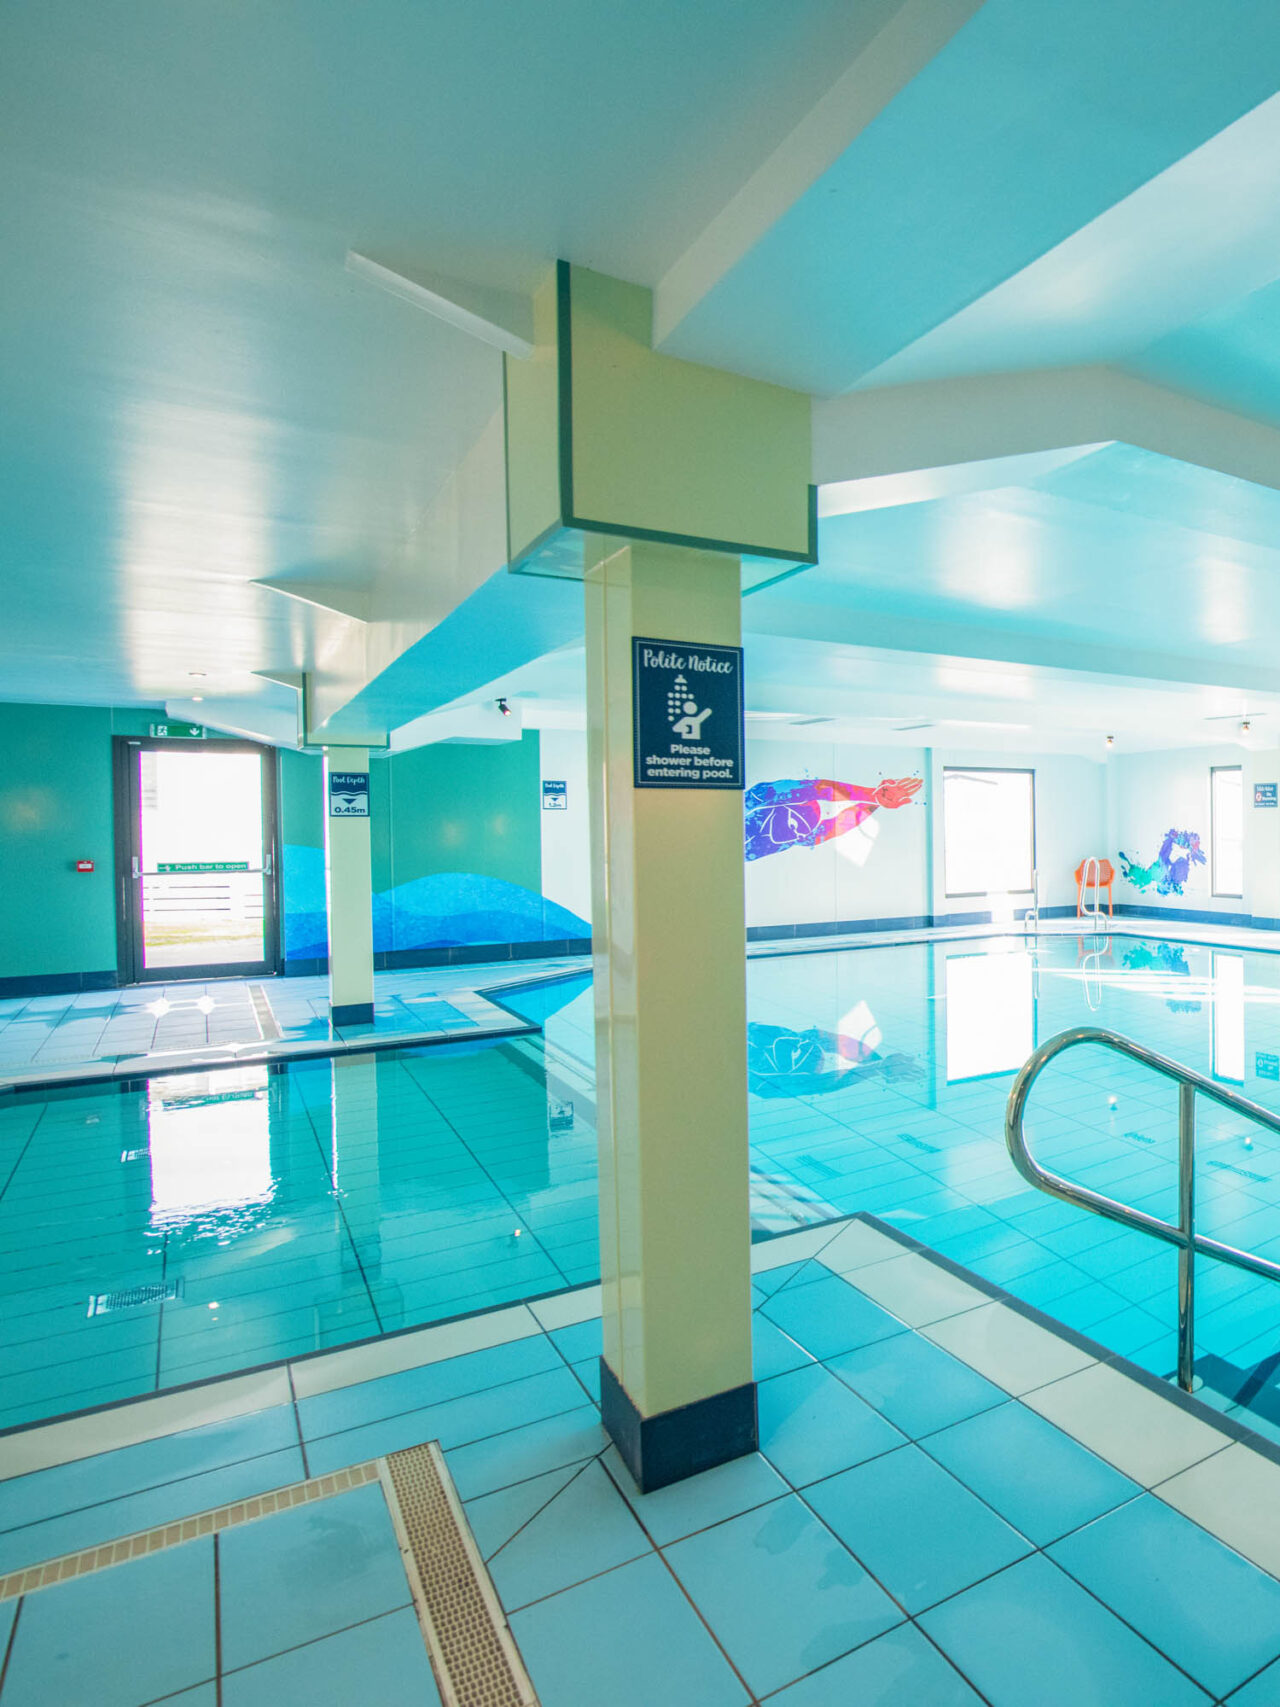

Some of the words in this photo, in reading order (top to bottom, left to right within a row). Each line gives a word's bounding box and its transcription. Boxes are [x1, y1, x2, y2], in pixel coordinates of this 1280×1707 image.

[643, 648, 686, 670] Polite
[688, 655, 733, 674] Notice
[670, 744, 711, 755] Please
[645, 755, 692, 766] shower
[693, 757, 734, 767] before
[647, 767, 700, 779] entering
[702, 769, 733, 779] pool.
[347, 776, 365, 785] Depth
